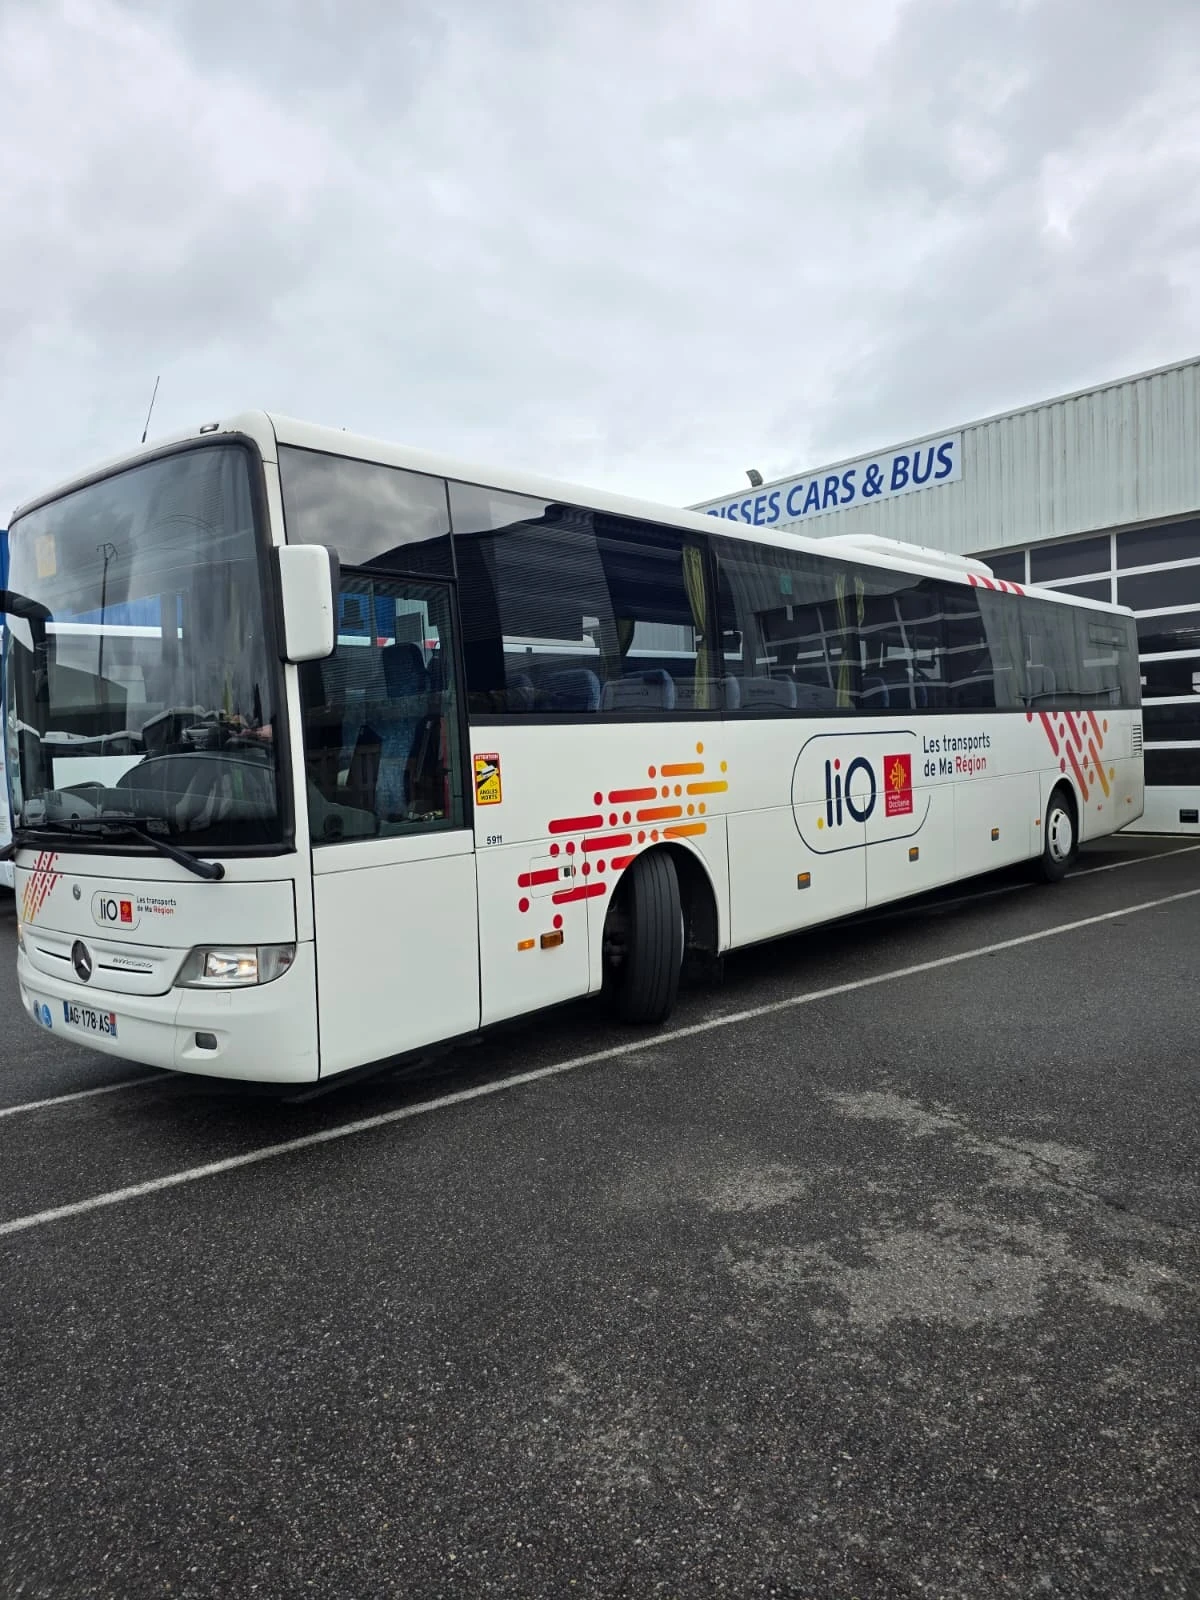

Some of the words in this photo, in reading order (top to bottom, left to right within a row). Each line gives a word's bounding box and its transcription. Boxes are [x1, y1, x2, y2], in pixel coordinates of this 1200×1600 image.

[786, 469, 856, 517] CARS
[862, 463, 884, 498] &
[890, 441, 954, 491] BUS
[923, 735, 940, 754] Les
[943, 732, 991, 753] transports
[924, 759, 936, 777] de
[939, 757, 953, 776] Ma
[955, 754, 987, 776] Région
[486, 835, 503, 845] 5911
[146, 896, 177, 906] transports
[70, 1006, 110, 1033] AG-178-AS
